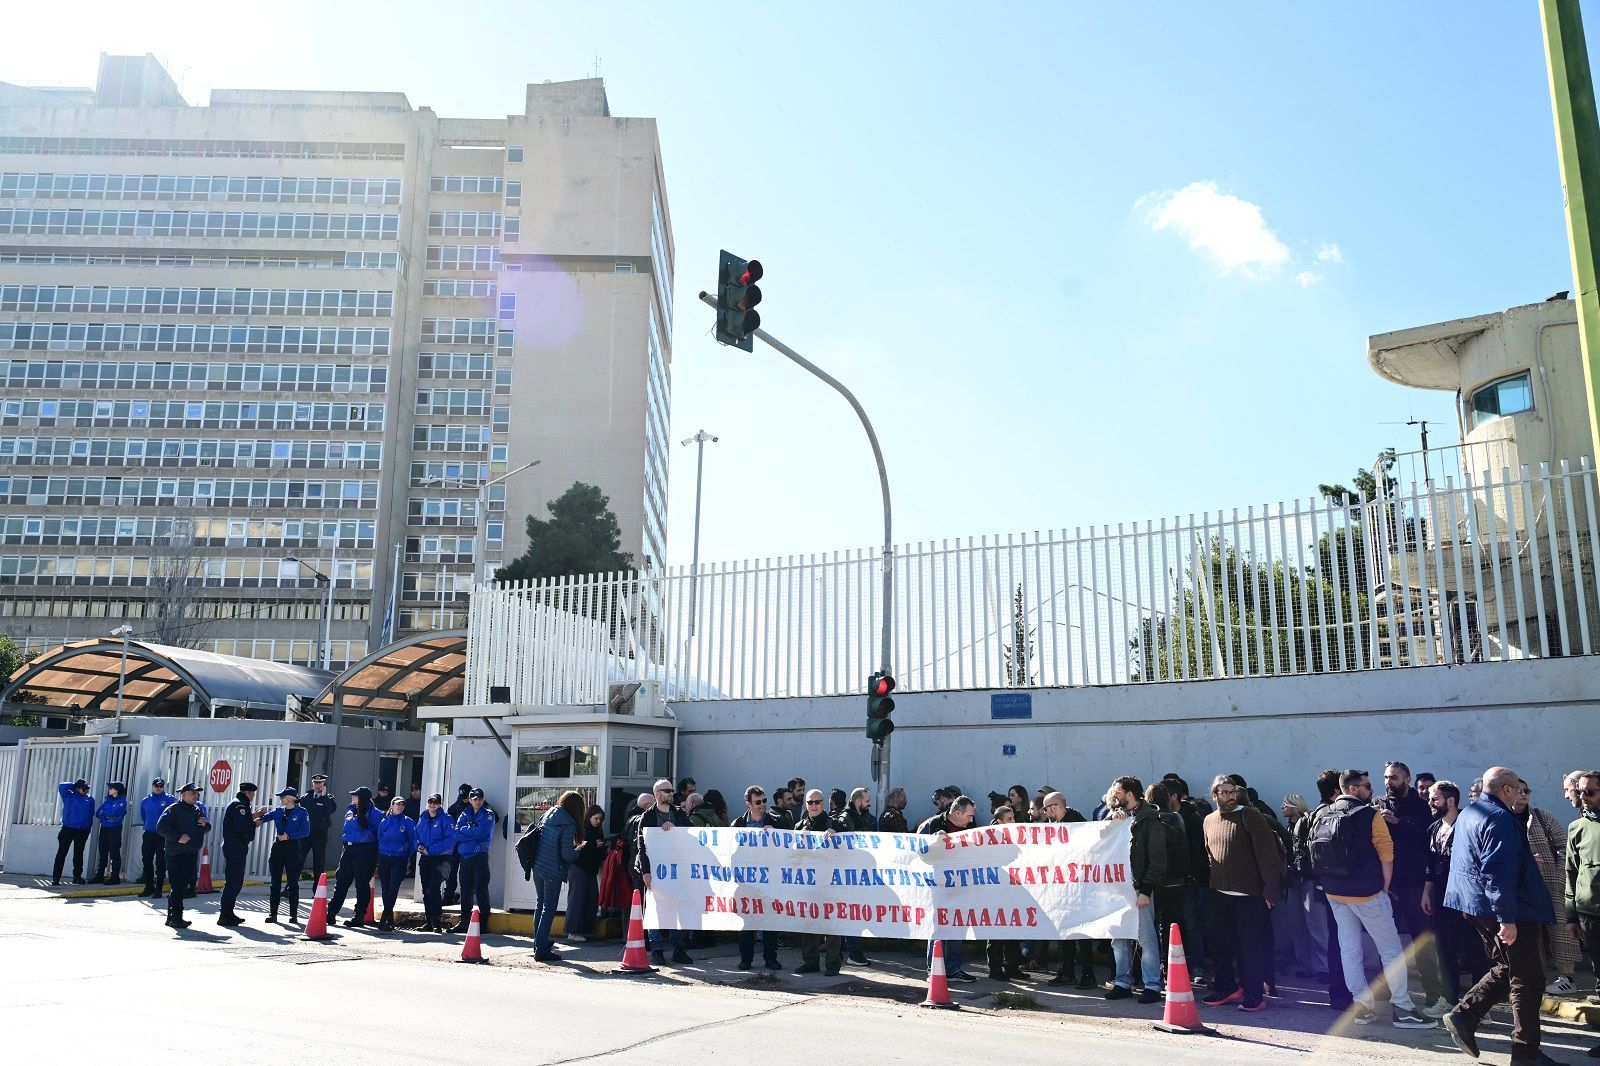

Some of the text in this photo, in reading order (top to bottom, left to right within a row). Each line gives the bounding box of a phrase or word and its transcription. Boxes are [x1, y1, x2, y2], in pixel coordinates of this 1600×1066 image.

[211, 769, 230, 785] STOP
[698, 829, 718, 846] ΟΙ
[893, 834, 929, 853] ΣΤΟ
[943, 825, 1069, 849] ΣΤΟΧΑΣΤΡΟ
[656, 863, 678, 879] ΟΙ
[690, 863, 769, 883] ΕΙΚΟΝΕΣ
[781, 867, 816, 885] ΜΑΣ
[944, 866, 1000, 887] ΣΤΗΝ
[1009, 863, 1125, 885] ΚΑΤΑΣΤΟΛΗ
[704, 895, 1037, 927] ΕΝΩΣΗ ΦΩΤΟΡΕΠΟΡΤΕΡ ΕΛΛΑΔΑΣ
